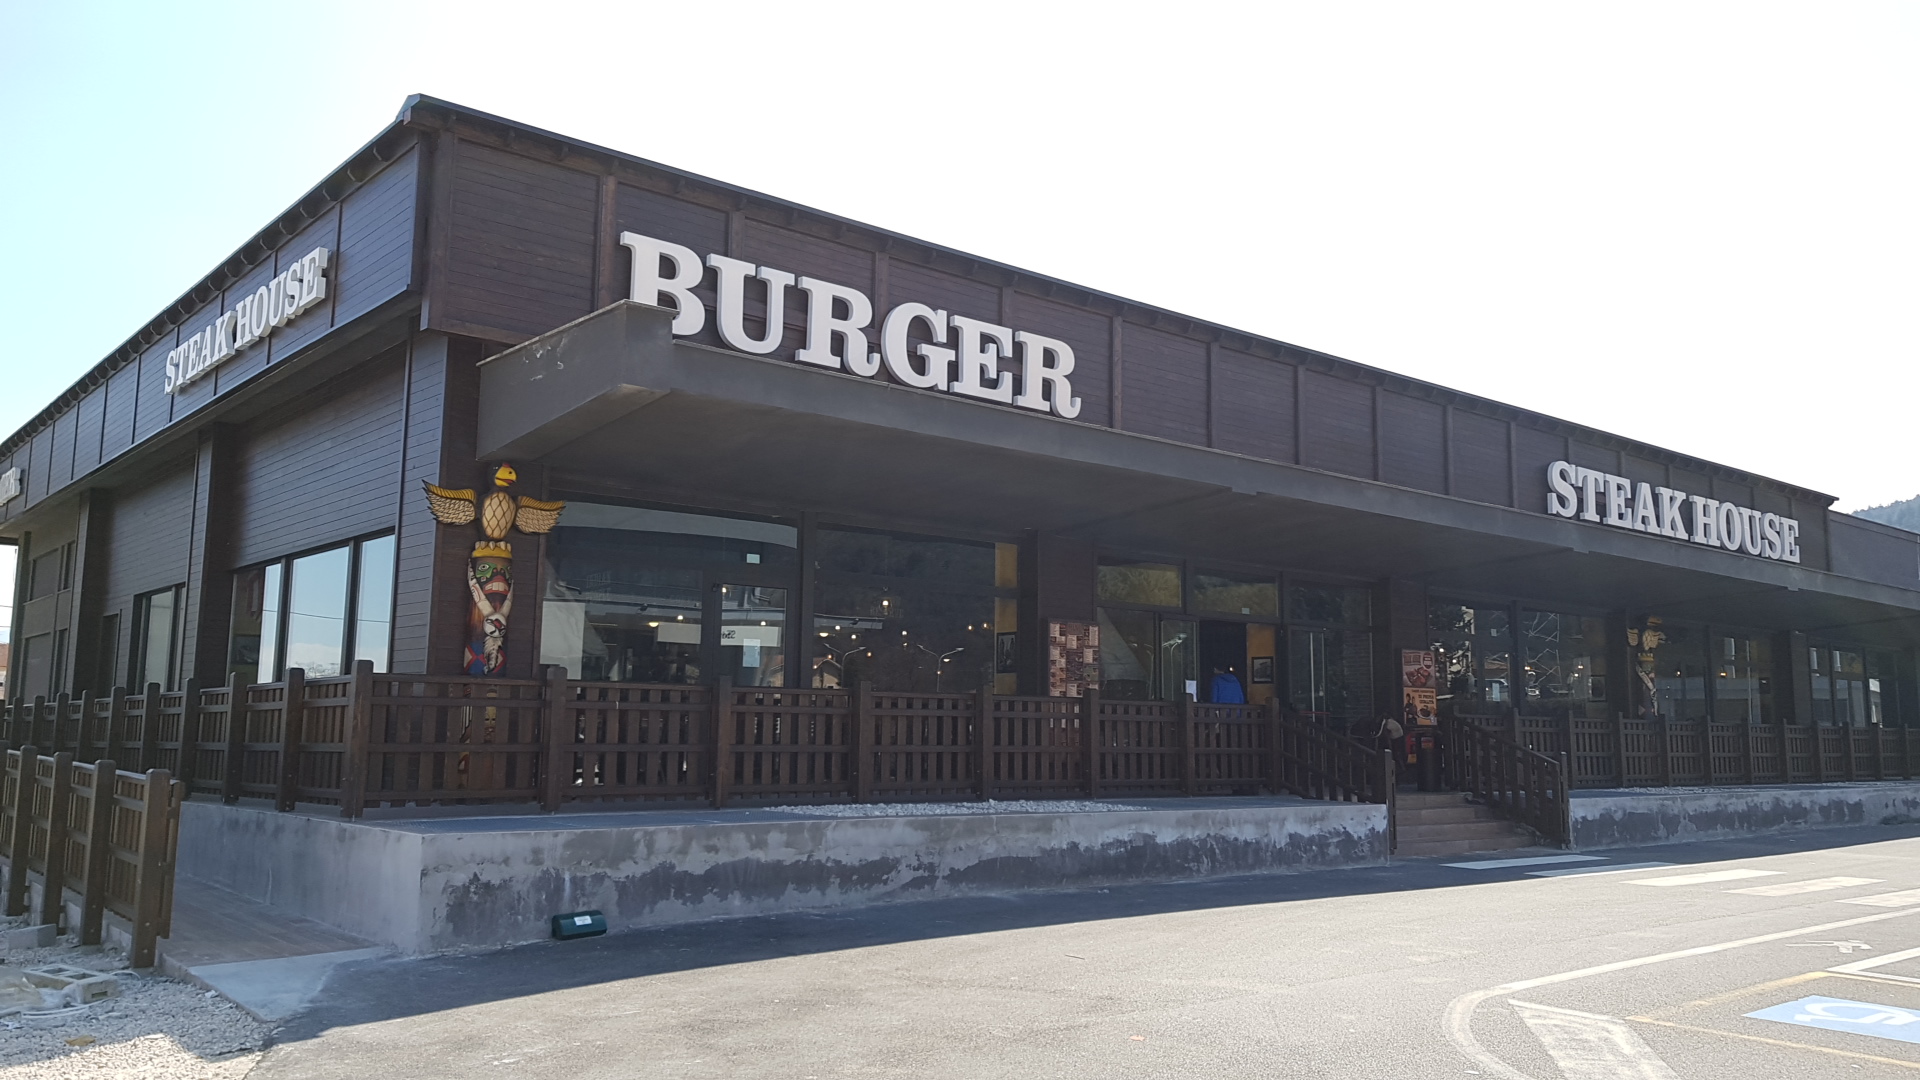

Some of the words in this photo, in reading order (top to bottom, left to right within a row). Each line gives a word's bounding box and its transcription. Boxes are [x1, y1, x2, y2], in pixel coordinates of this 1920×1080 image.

[164, 310, 236, 395] STEAK
[234, 247, 328, 350] HOUSE
[620, 231, 1082, 419] BURGER
[1547, 460, 1688, 541] STEAK
[1689, 494, 1800, 563] HOUSE
